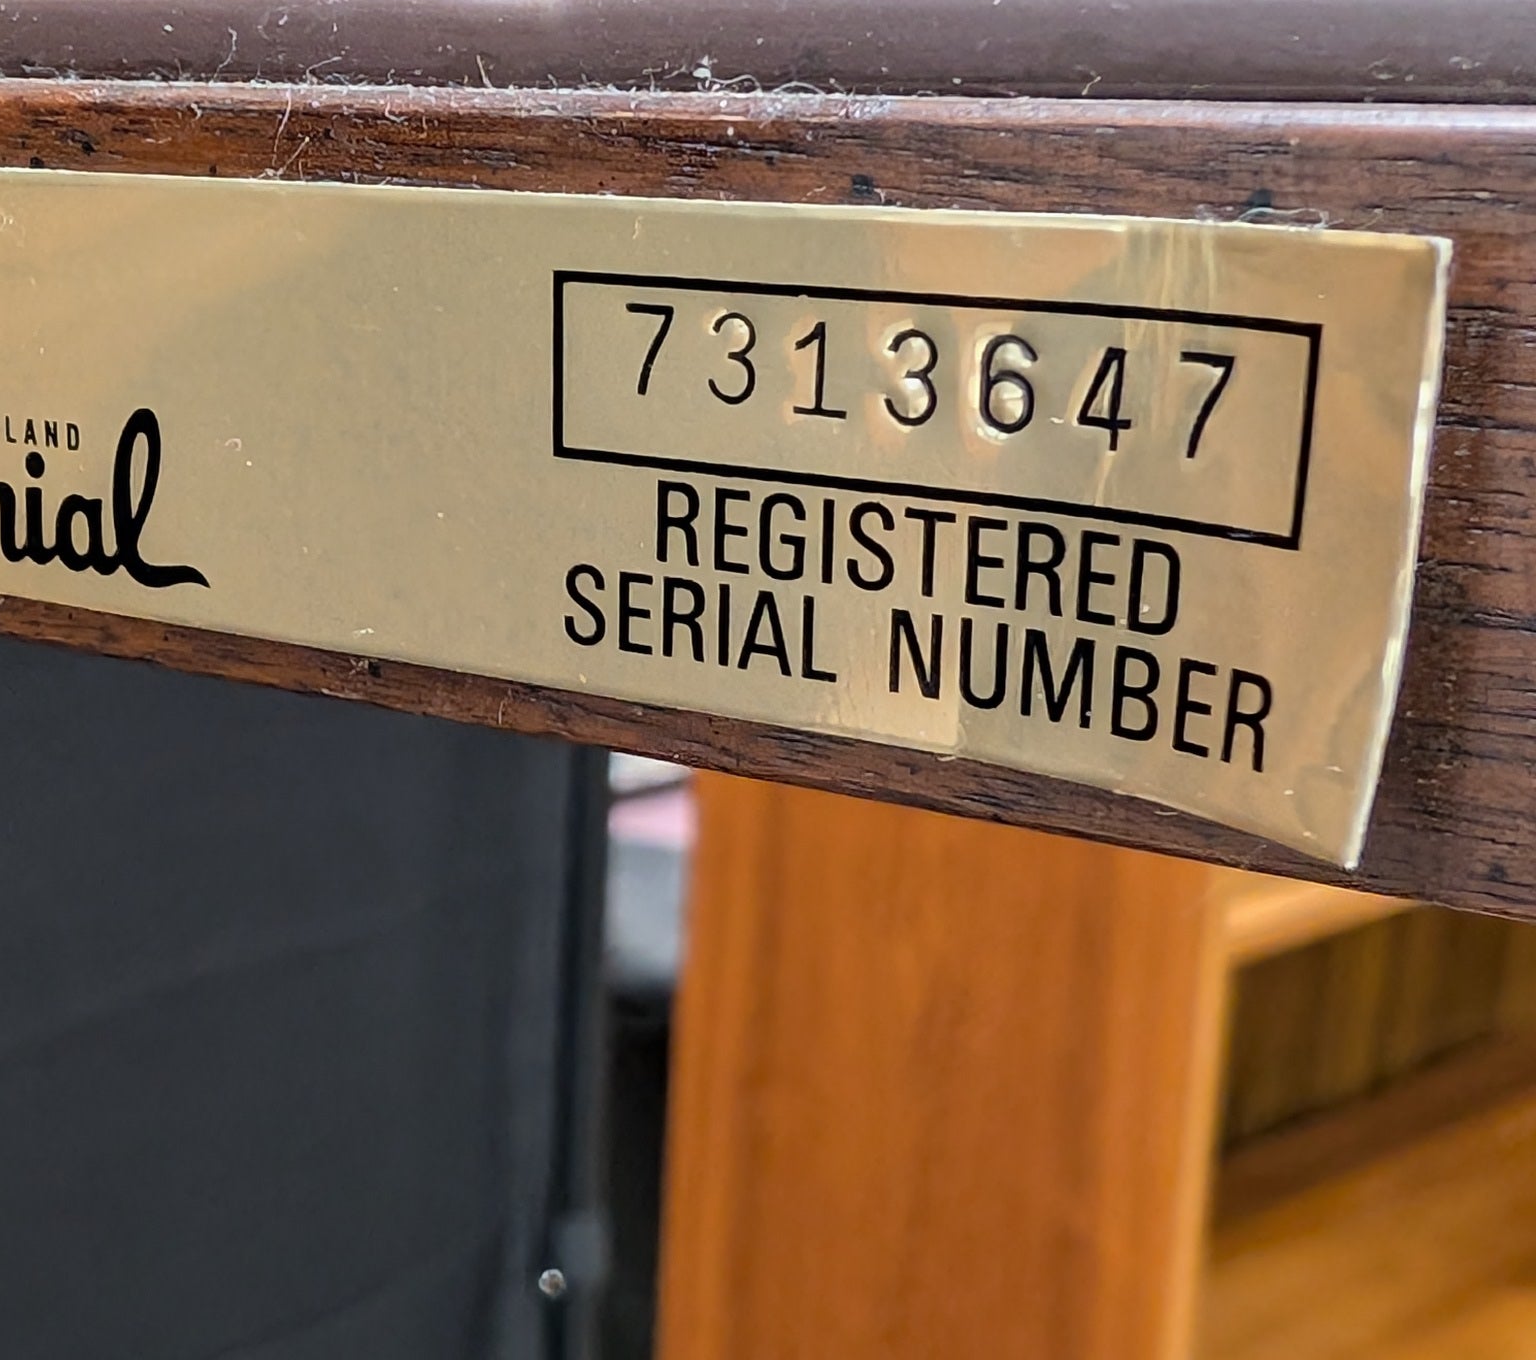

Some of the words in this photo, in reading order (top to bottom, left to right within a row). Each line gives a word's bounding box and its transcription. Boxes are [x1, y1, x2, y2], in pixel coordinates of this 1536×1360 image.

[624, 302, 1237, 460] 7313647
[654, 478, 1183, 637] REGISTERED
[563, 563, 838, 684] SERIAL
[887, 607, 1276, 774] NUMBER
